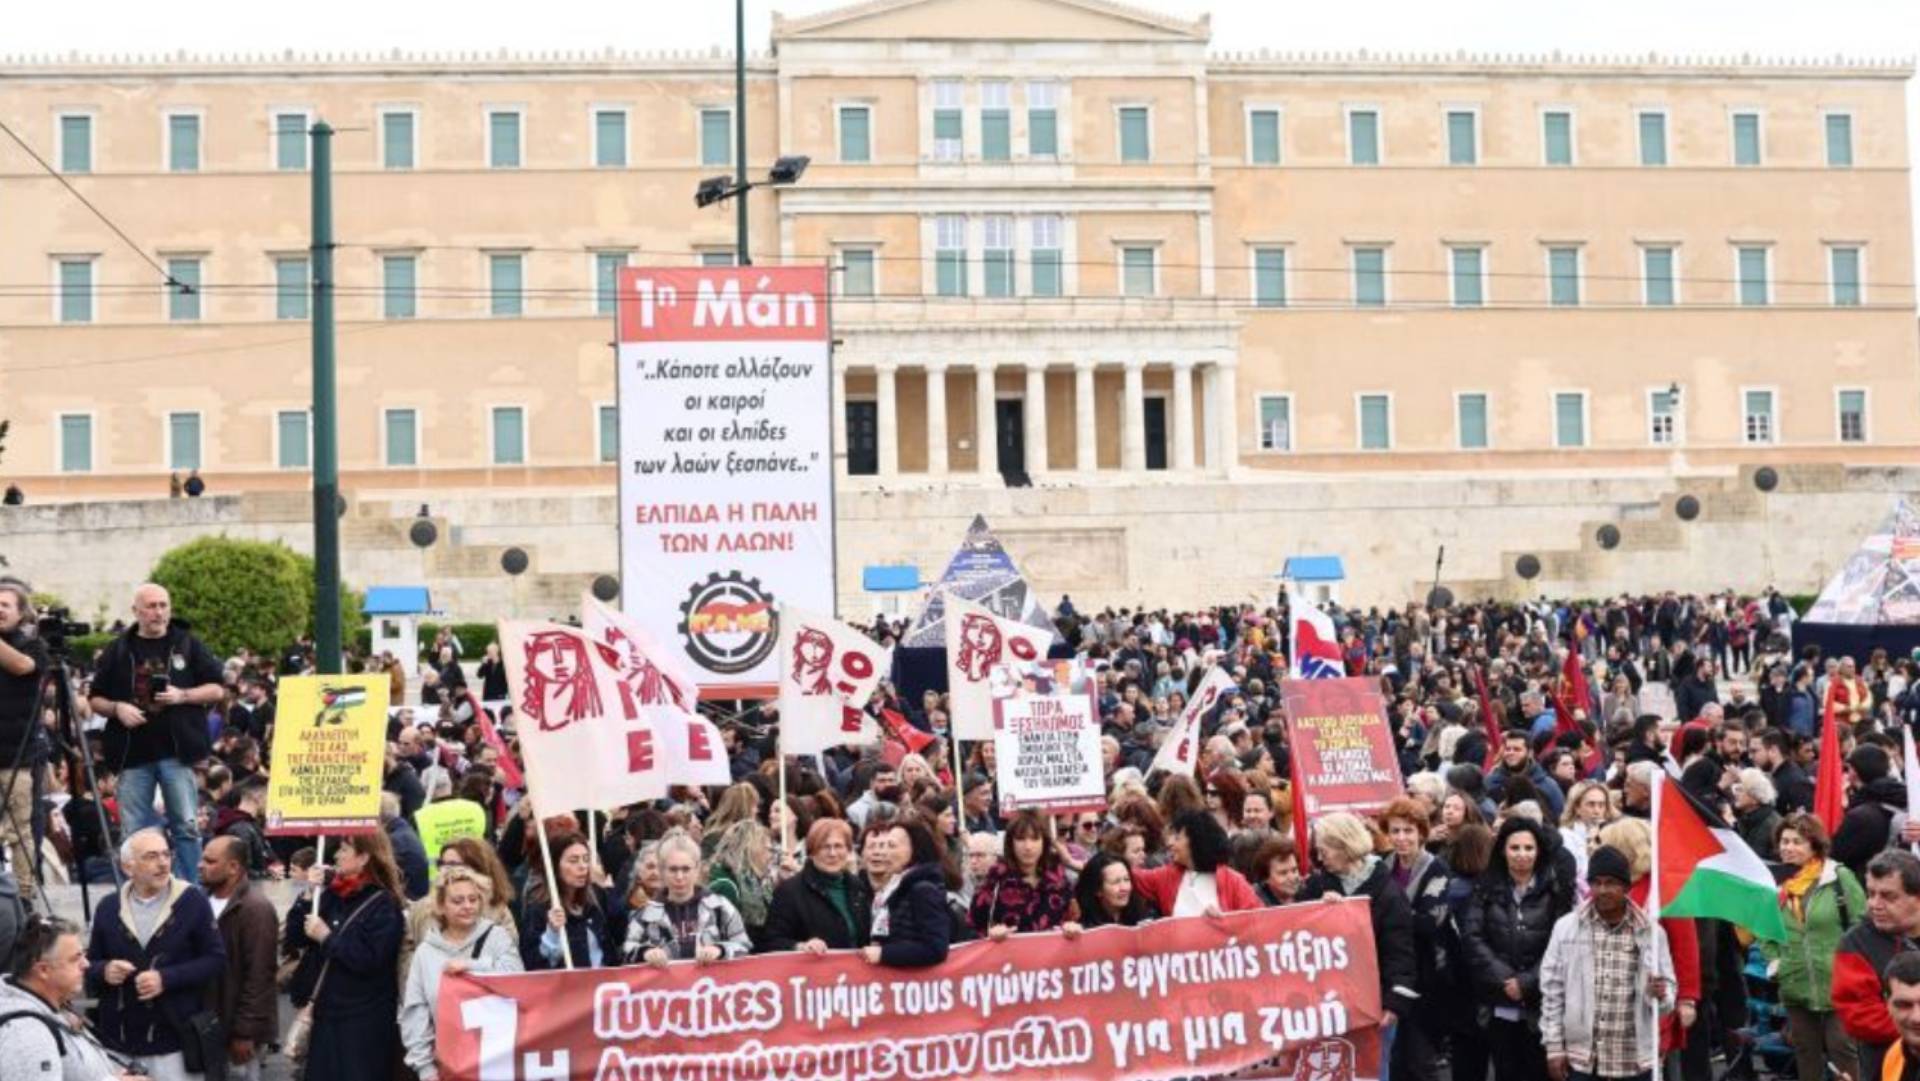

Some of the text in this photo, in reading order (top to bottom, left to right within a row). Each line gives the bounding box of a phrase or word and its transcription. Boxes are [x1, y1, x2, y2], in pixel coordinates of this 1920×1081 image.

[635, 275, 817, 329] 1η Μάη
[724, 356, 813, 382] αλλάζουν
[684, 389, 767, 415] οι καιροί
[664, 418, 787, 442] και οι ελπίδες
[633, 459, 666, 474] των
[671, 451, 720, 475] λαών
[636, 502, 818, 524] ΕΛΠΙΔΑ Η ΠΑΛΗ
[660, 532, 794, 552] ΤΩΝ ΛΑΩΝ!
[594, 930, 1349, 1038] Γυναίκες Τιμάμε τους αγώνες της εργατικής τάξης
[903, 1032, 978, 1079] την
[983, 1014, 1093, 1073] πάλη
[1106, 1019, 1171, 1068] για
[1183, 1010, 1248, 1061] μια
[1257, 989, 1348, 1050] ζωή
